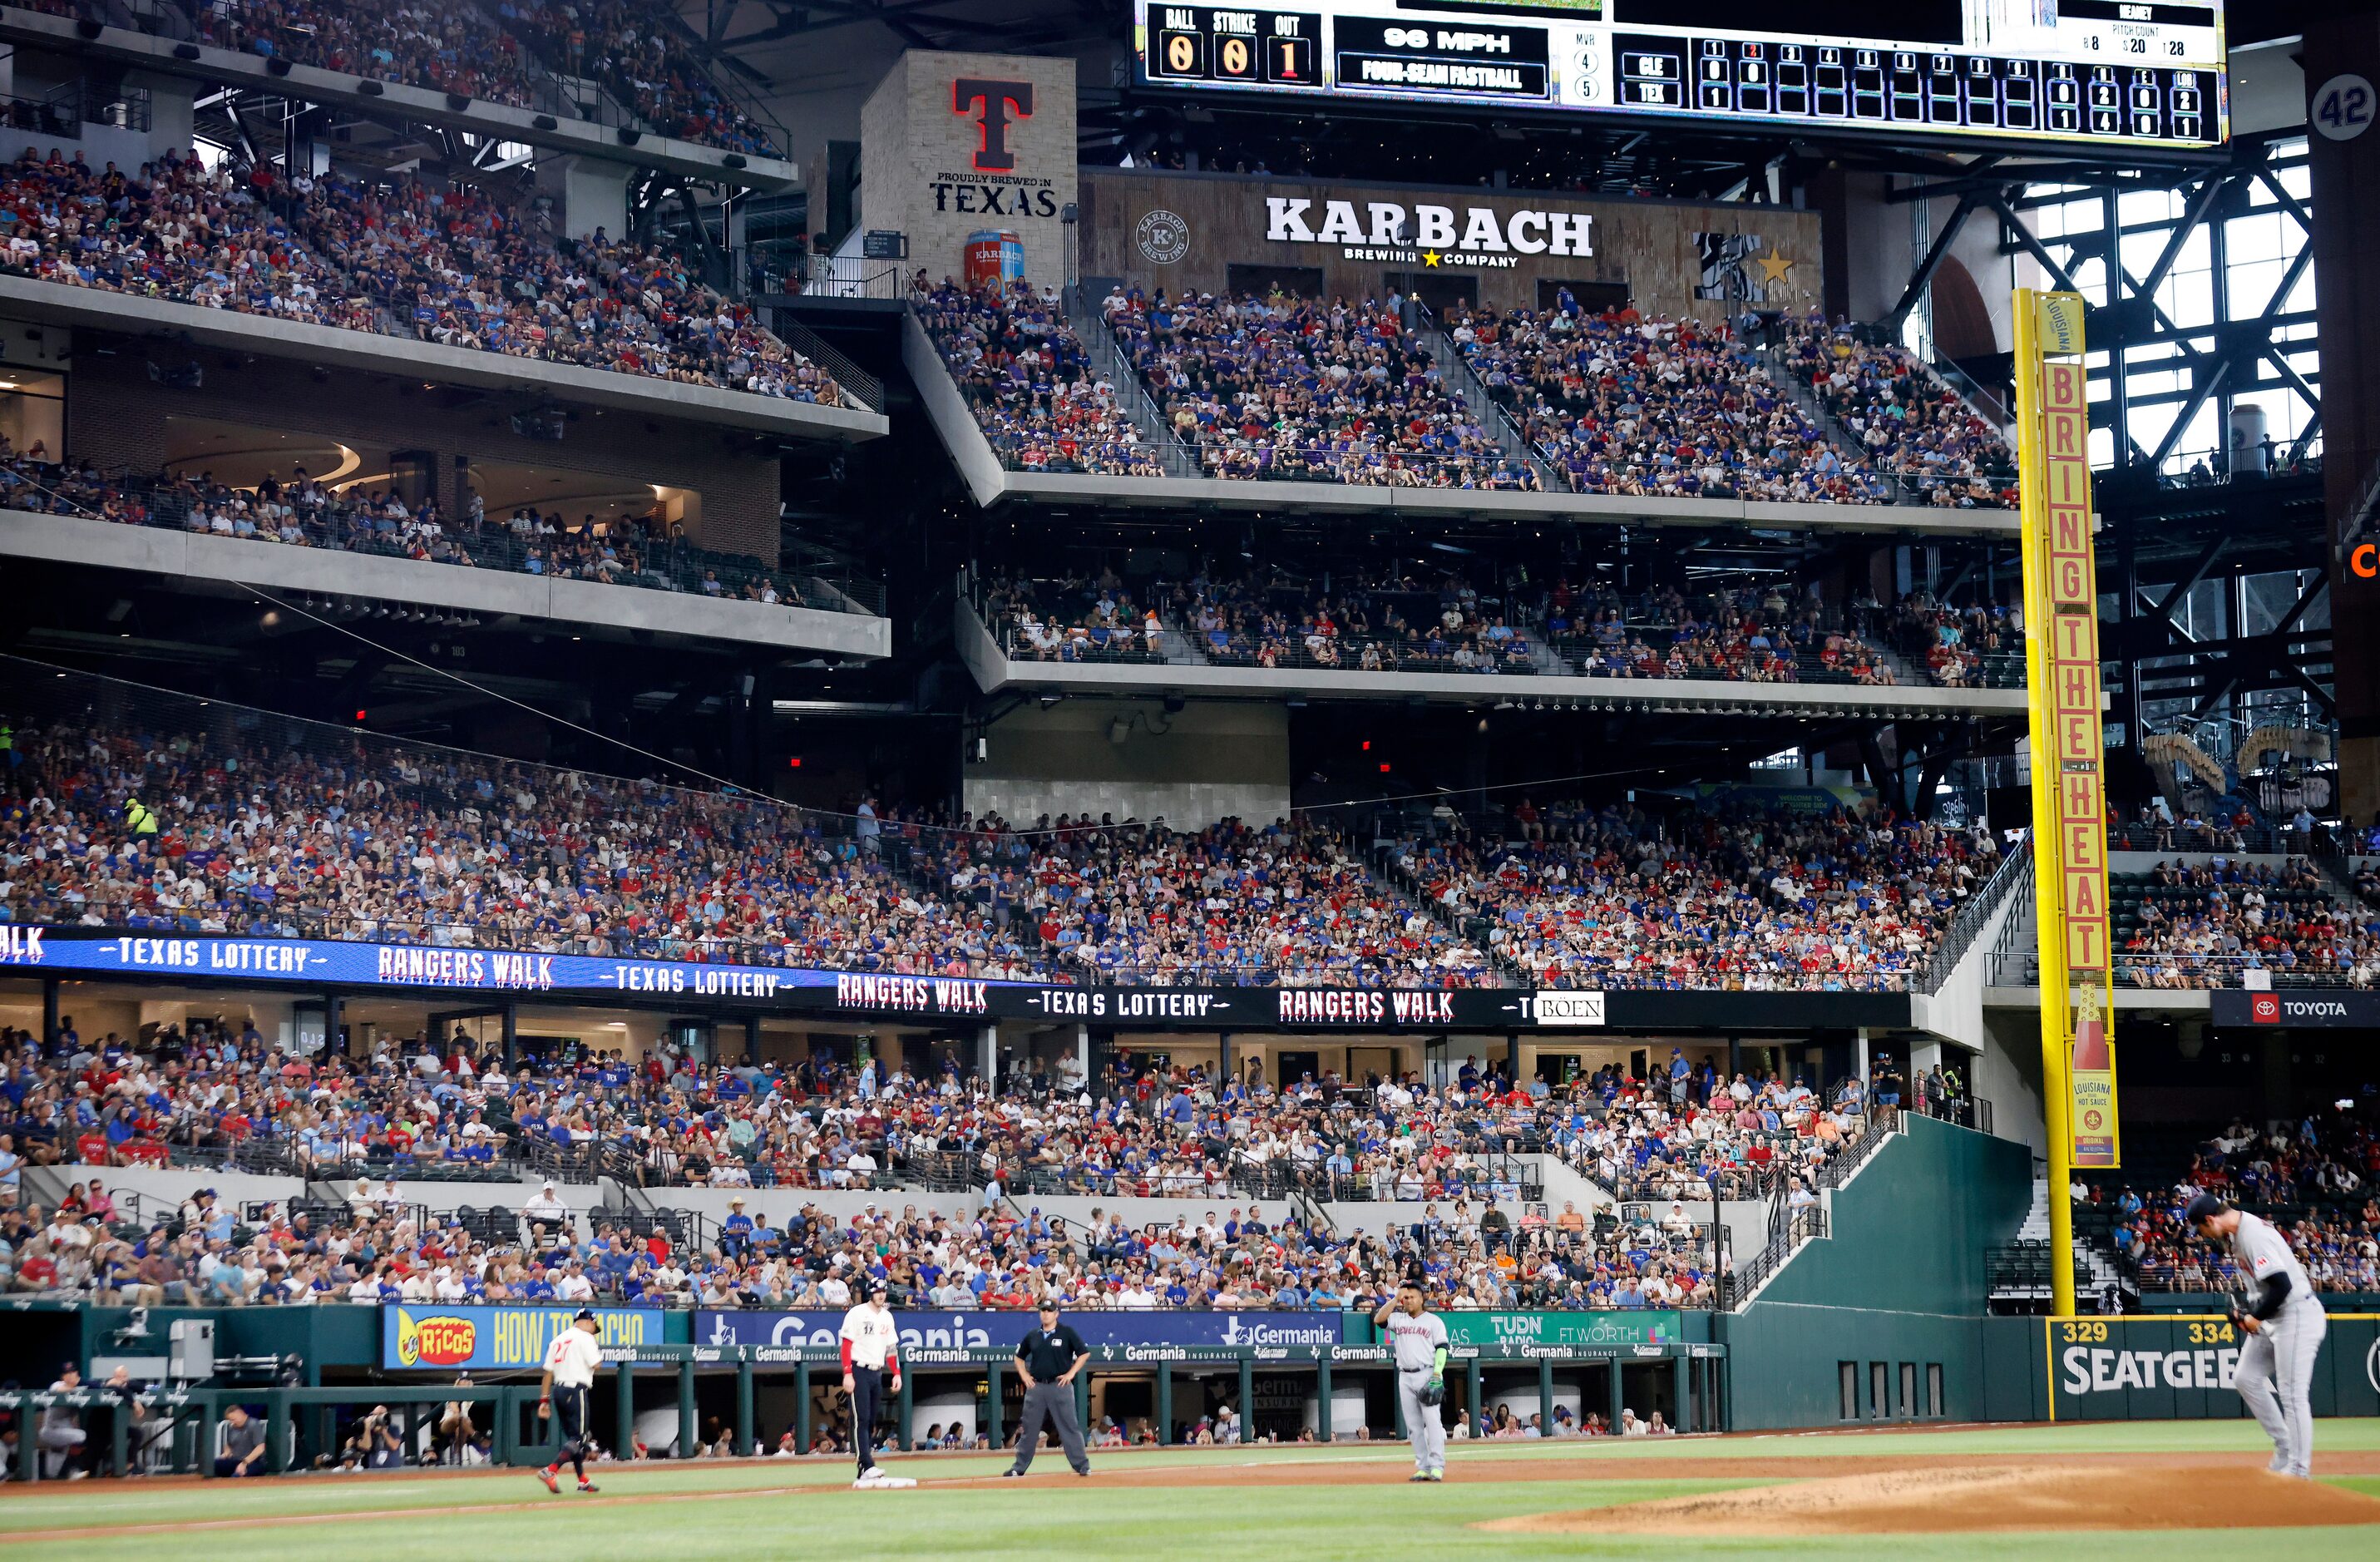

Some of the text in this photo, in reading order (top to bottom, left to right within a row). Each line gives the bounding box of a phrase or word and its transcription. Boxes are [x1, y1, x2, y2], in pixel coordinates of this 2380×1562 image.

[1165, 8, 1196, 30] BALL
[1212, 12, 1257, 33] STRIKE
[1275, 15, 1300, 37] OUT
[1384, 27, 1510, 52] 96 MPH
[1576, 33, 1595, 46] MVR
[2112, 24, 2159, 37] PITCH COUNT
[1169, 36, 1193, 71] 0
[2092, 36, 2100, 51] 8
[2131, 38, 2145, 53] 20
[2170, 41, 2185, 56] 28
[1223, 39, 1247, 74] 0
[1281, 42, 1298, 77] 1
[1582, 54, 1589, 69] 4
[1711, 42, 1717, 55] 1
[1750, 44, 1757, 57] 2
[1939, 57, 1946, 70] 7
[2141, 70, 2147, 83] E
[1362, 60, 1523, 89] FOUR-SEAM FASTBALL
[1639, 57, 2190, 110] CLE 0 0 0 2 0 2
[1583, 82, 1590, 96] 5
[1639, 83, 2190, 136] TEX 1 1 4 0 1
[2318, 85, 2368, 126] 42
[953, 79, 1034, 171] T
[937, 172, 989, 183] PROUDLY
[990, 175, 1038, 187] BREWED
[929, 182, 1057, 217] TEXAS
[1140, 213, 1185, 233] KARBACH
[1266, 197, 1593, 258] KARBACH
[1153, 229, 1169, 245] K
[975, 250, 1023, 262] KARBACH
[1140, 240, 1185, 261] BREWING
[1344, 248, 1518, 268] BREWING COMPANY
[2047, 300, 2071, 350] LOUISIANA
[2054, 367, 2096, 965] BRING THE HEAT
[1778, 794, 1813, 803] WELCOME
[0, 926, 46, 964] ALK
[118, 937, 308, 971] TEXAS LOTTERY
[378, 947, 554, 991] RANGERS WALK
[615, 966, 778, 997] TEXAS LOTTERY
[837, 973, 989, 1015] RANGERS WALK
[1041, 990, 1209, 1016] TEXAS LOTTERY
[1279, 990, 1455, 1024] RANGERS WALK
[1540, 996, 1602, 1018] BÖEN
[2284, 1002, 2348, 1016] TOYOTA
[2074, 1081, 2111, 1095] LOUISIANA
[1254, 1323, 1334, 1345] Germania
[1490, 1316, 1542, 1335] TUDN
[1559, 1326, 1640, 1342] FT WORTH
[2063, 1322, 2108, 1342] 329
[2188, 1323, 2234, 1343] 334
[494, 1311, 644, 1364] HOW T ACHO
[552, 1339, 573, 1363] 27
[600, 1346, 680, 1362] rmania INSURANCE
[756, 1345, 841, 1362] Germania INSURANCE
[906, 1347, 1014, 1362] Germania INSURAN
[1125, 1345, 1238, 1362] Germania INSURANCE
[1331, 1345, 1387, 1360] Germania
[1521, 1345, 1617, 1358] Germania INSURANCE
[1691, 1344, 1709, 1357] Germania
[2063, 1346, 2279, 1396] SEATGEE
